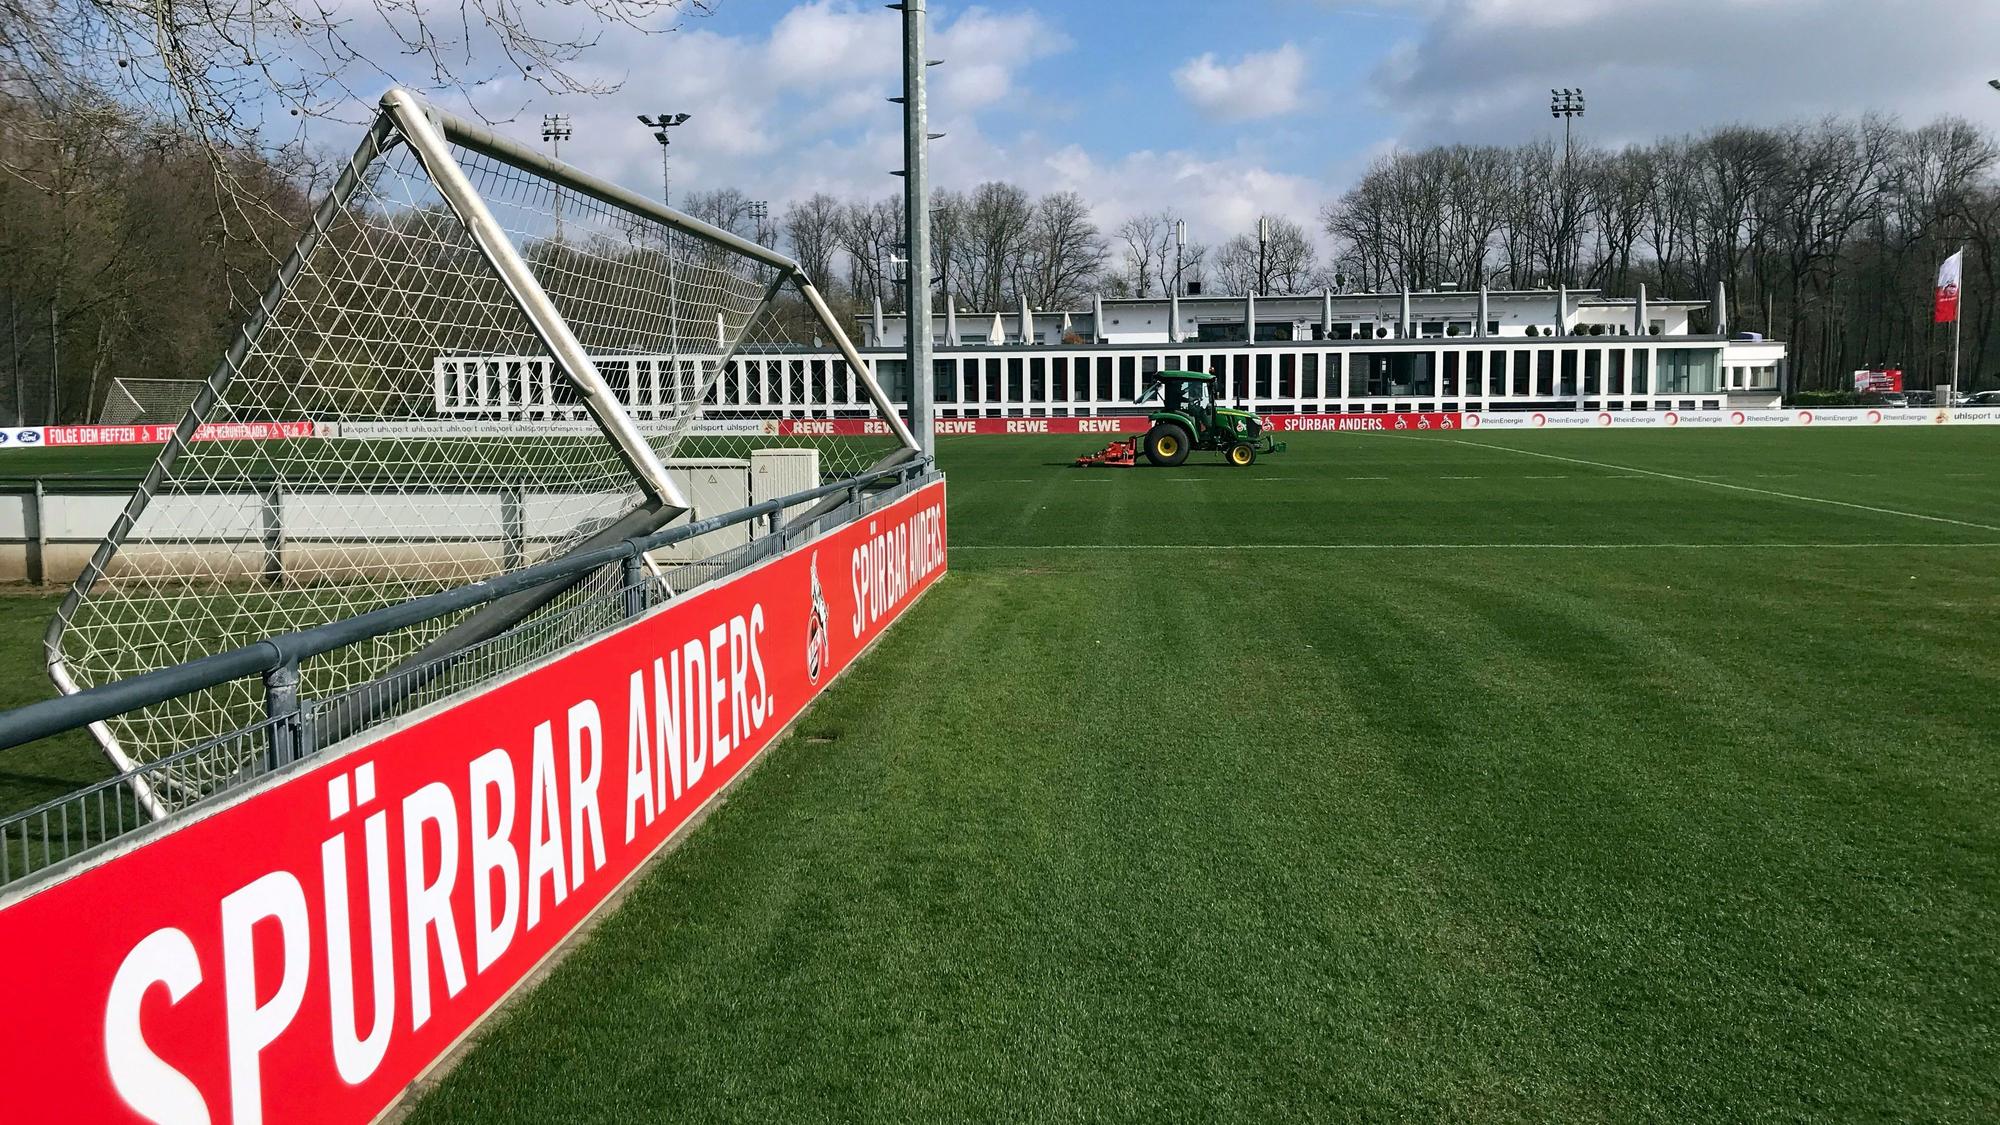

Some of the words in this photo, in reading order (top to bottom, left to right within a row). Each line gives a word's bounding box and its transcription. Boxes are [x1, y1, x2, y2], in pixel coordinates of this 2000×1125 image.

[1284, 416, 1335, 431] SPÜRBAR
[1338, 417, 1386, 431] ANDERS.
[1481, 417, 1524, 425] RheinEnergie
[1547, 416, 1590, 425] RheinEnergie
[1613, 416, 1656, 424] RheinEnergie
[1680, 415, 1723, 423] RheinEnergie
[1747, 415, 1790, 423] RheinEnergie
[1814, 414, 1858, 422] RheinEnergie
[1883, 413, 1927, 421] RheinEnergie
[1954, 412, 1991, 421] uhlsport
[156, 427, 177, 441] JETZ
[691, 424, 724, 432] uhlsport
[726, 424, 760, 432] uhlsport
[793, 421, 834, 434] REWE
[863, 421, 894, 434] REW
[935, 420, 976, 434] REWE
[1006, 420, 1048, 433] REWE
[1078, 419, 1121, 432] REWE
[50, 428, 77, 443] FOLGE
[80, 428, 98, 443] DEM
[100, 427, 136, 442] #EFFZEH
[851, 520, 909, 639] SPÜRBAR
[909, 502, 945, 589] ANDERS.
[104, 698, 607, 1125] SPÜRBAR
[625, 603, 775, 844] ANDERS.
